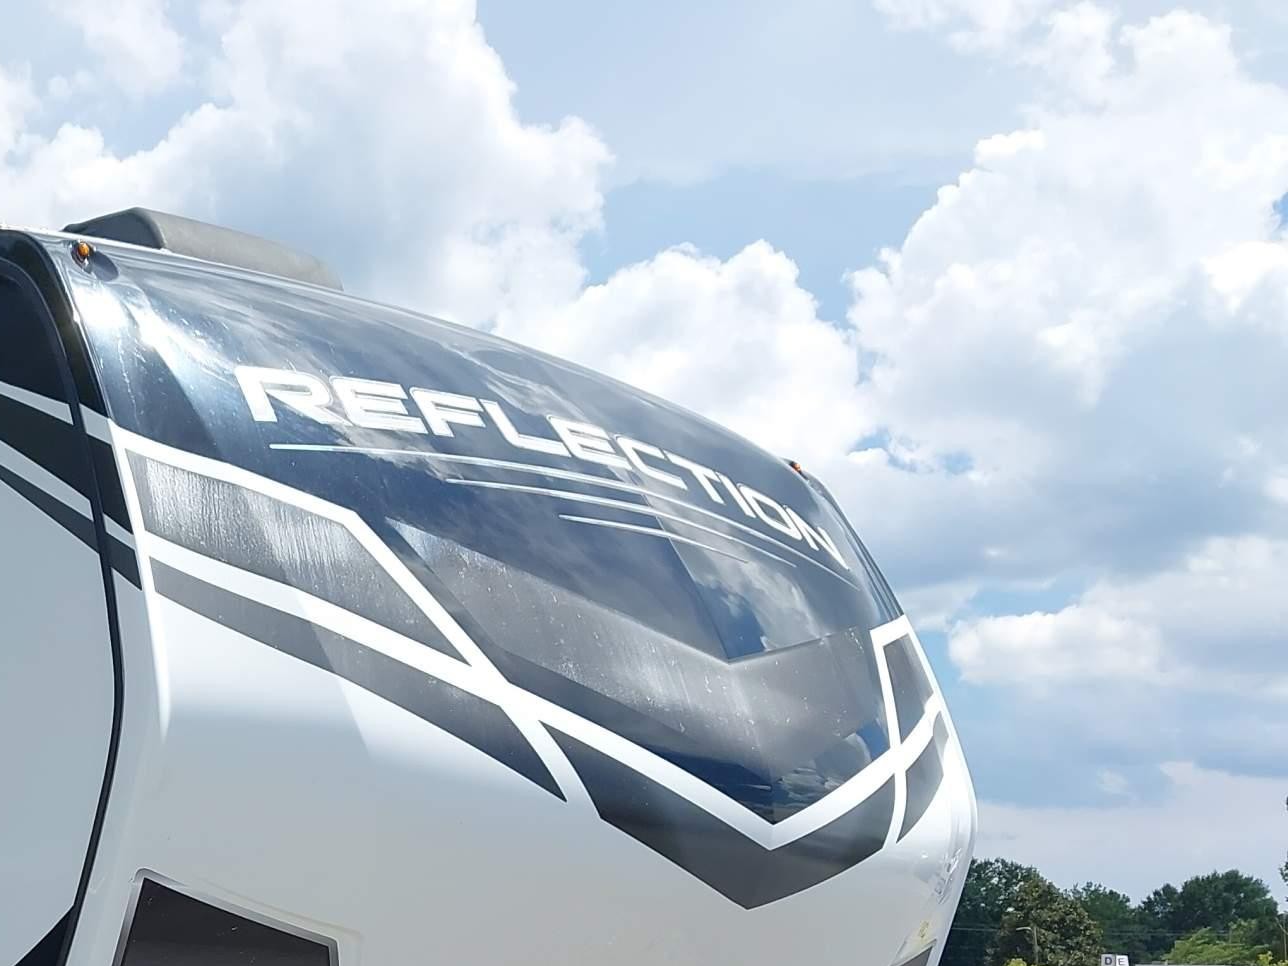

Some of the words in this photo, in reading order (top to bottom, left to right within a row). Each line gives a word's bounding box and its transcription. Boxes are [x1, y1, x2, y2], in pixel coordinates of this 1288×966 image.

[233, 366, 850, 570] REFLECTION
[1104, 956, 1113, 966] D
[1118, 957, 1126, 966] E
